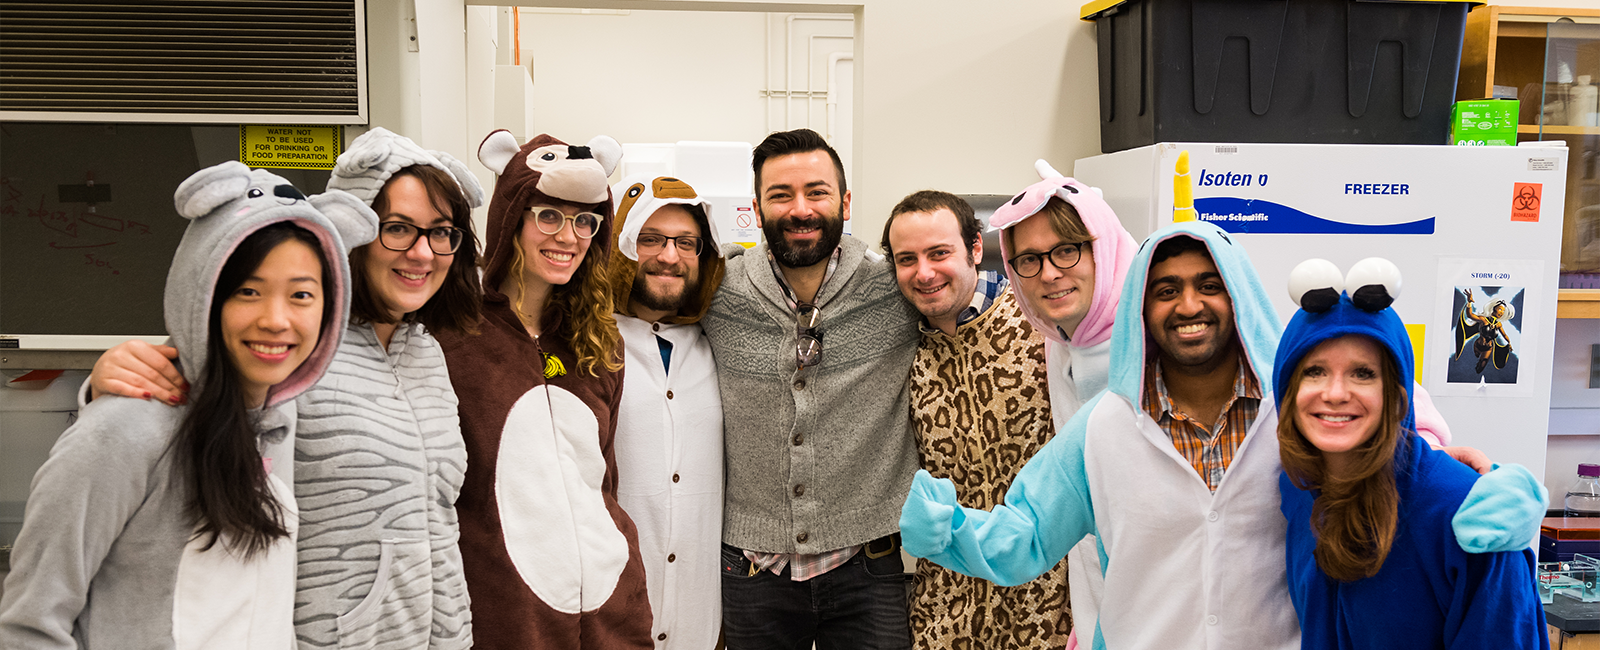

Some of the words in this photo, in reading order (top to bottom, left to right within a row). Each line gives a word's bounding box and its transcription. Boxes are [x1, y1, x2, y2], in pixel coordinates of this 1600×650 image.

[279, 136, 290, 144] BE
[274, 144, 310, 152] DRINKING
[252, 151, 274, 159] FOOD
[277, 152, 328, 160] PREPARATION
[1344, 183, 1410, 195] FREEZER
[1200, 212, 1228, 221] Fisher
[1228, 212, 1269, 222] Scientific
[1494, 272, 1511, 280] (-20)
